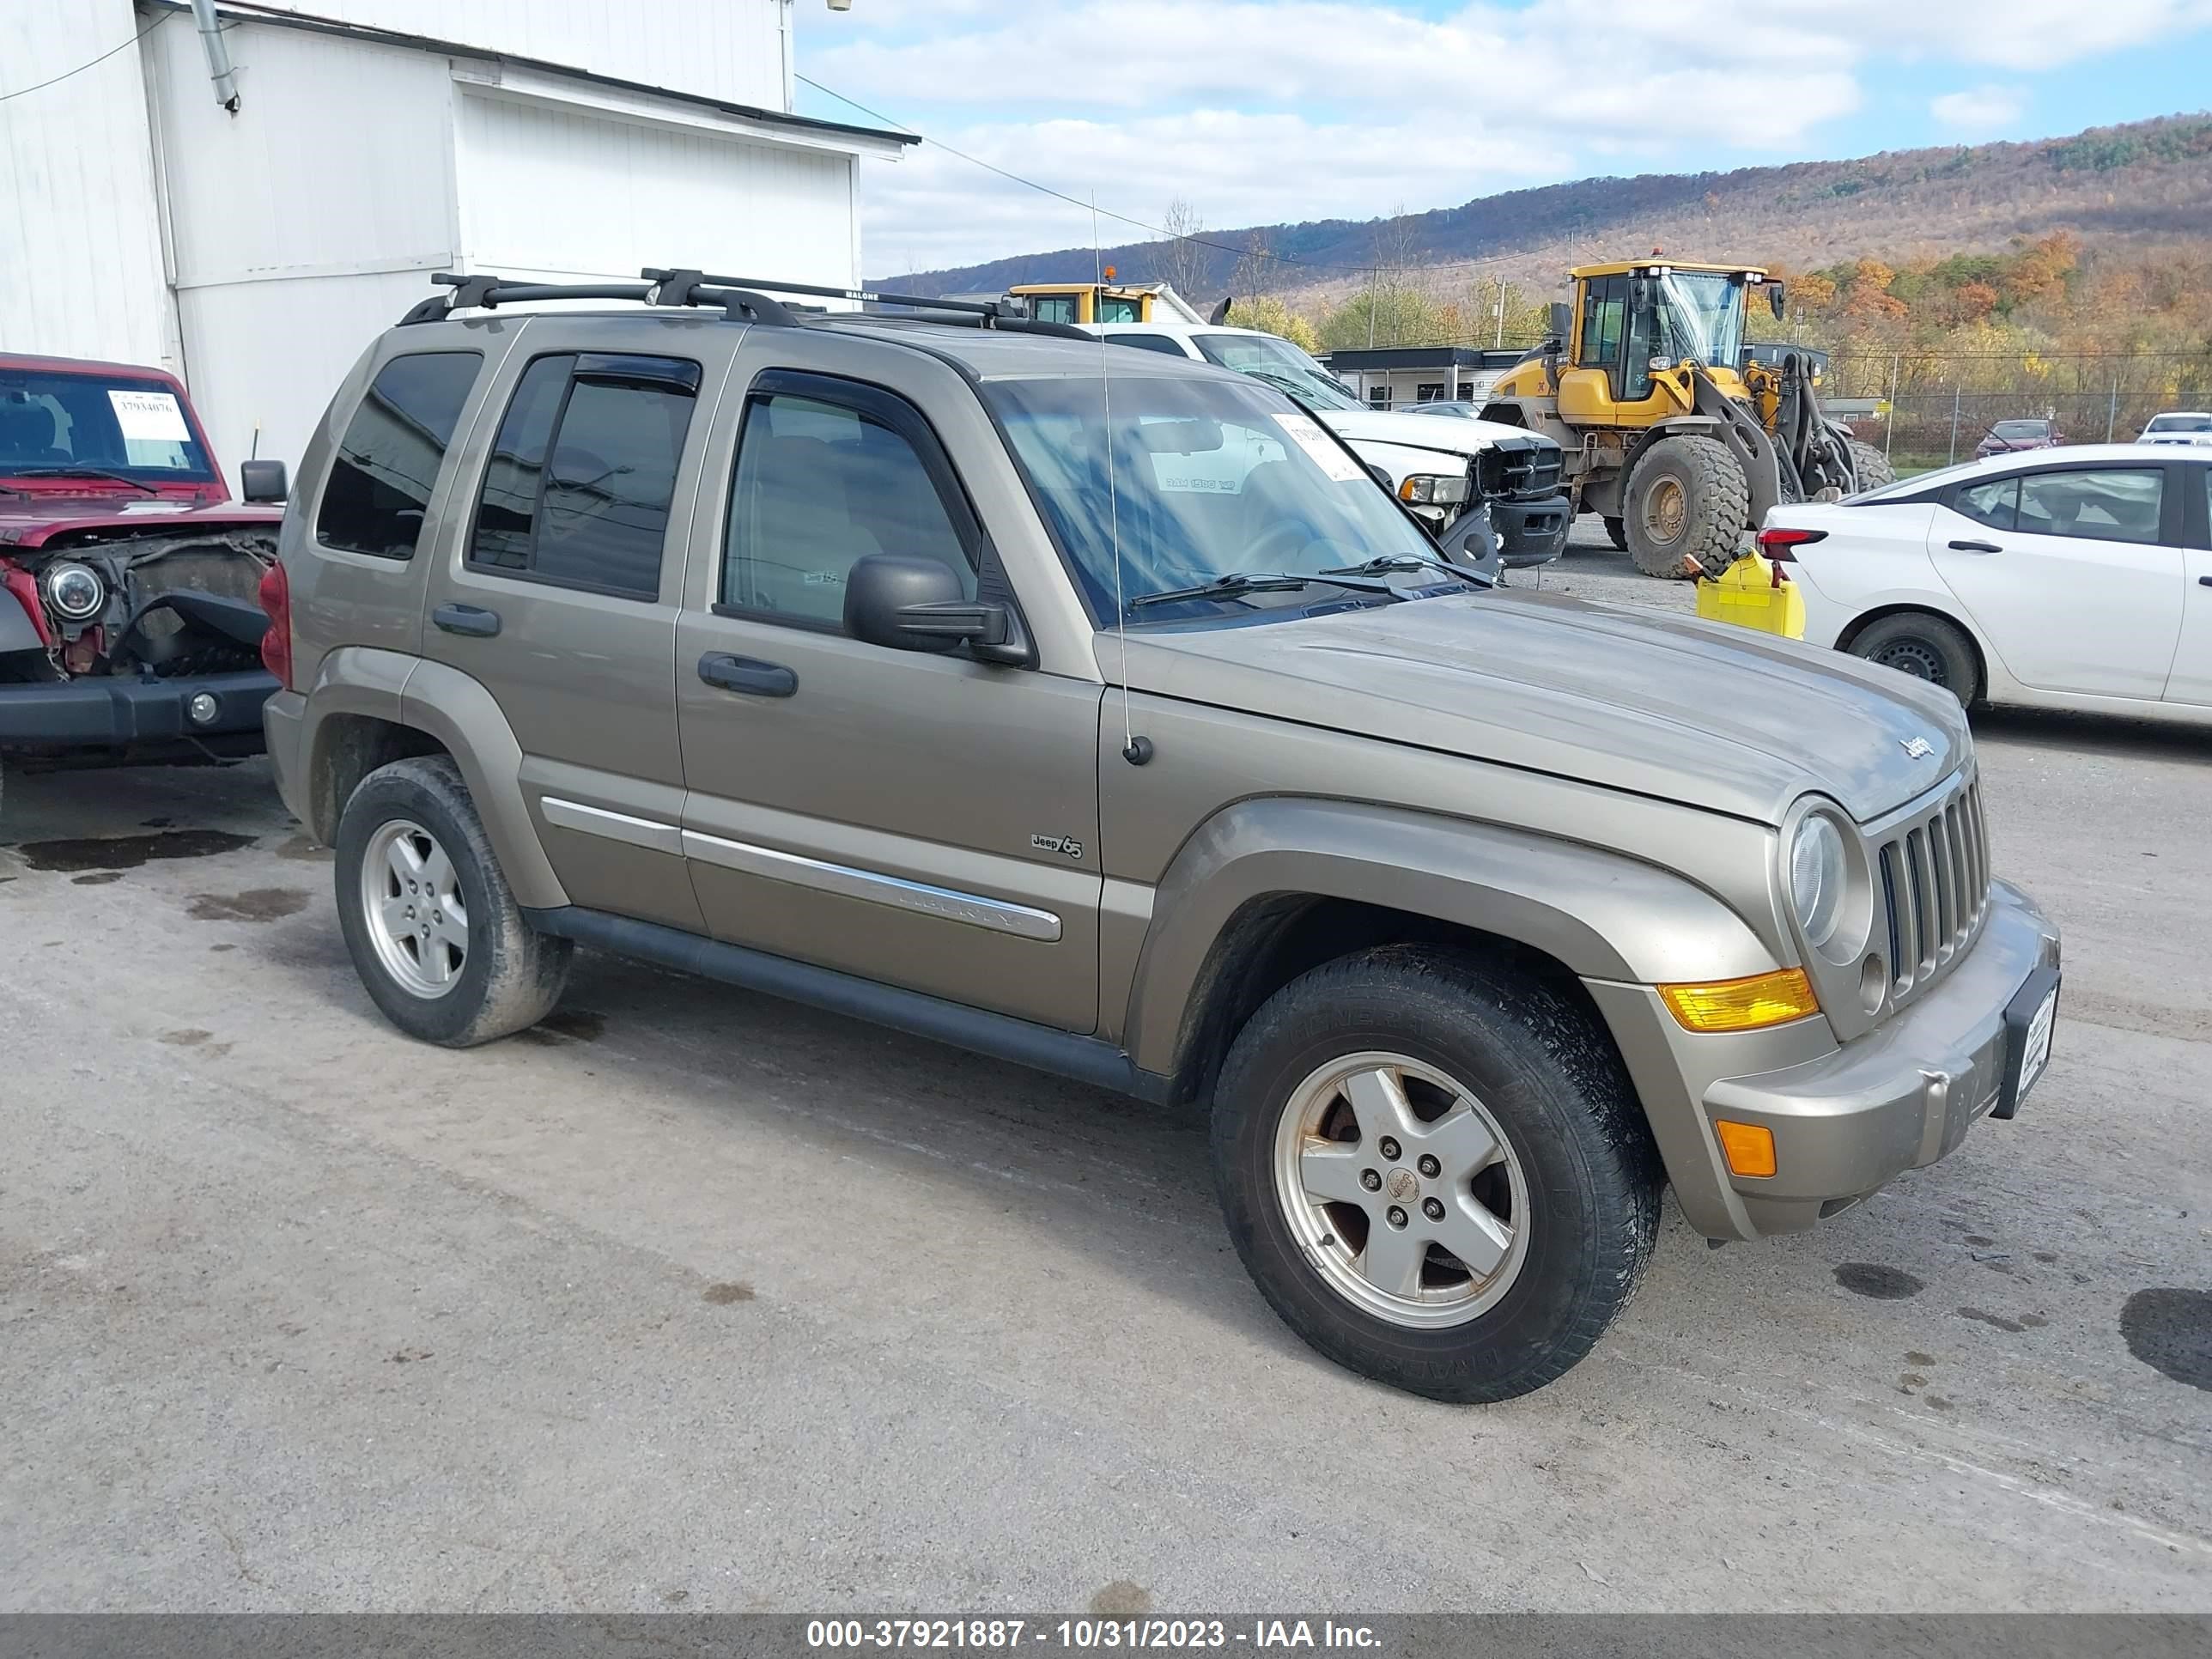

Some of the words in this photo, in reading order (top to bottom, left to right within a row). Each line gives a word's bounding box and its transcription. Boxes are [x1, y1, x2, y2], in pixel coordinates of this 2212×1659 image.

[845, 291, 879, 301] MALONE
[1033, 836, 1058, 850] Jeep
[1062, 835, 1083, 859] 65
